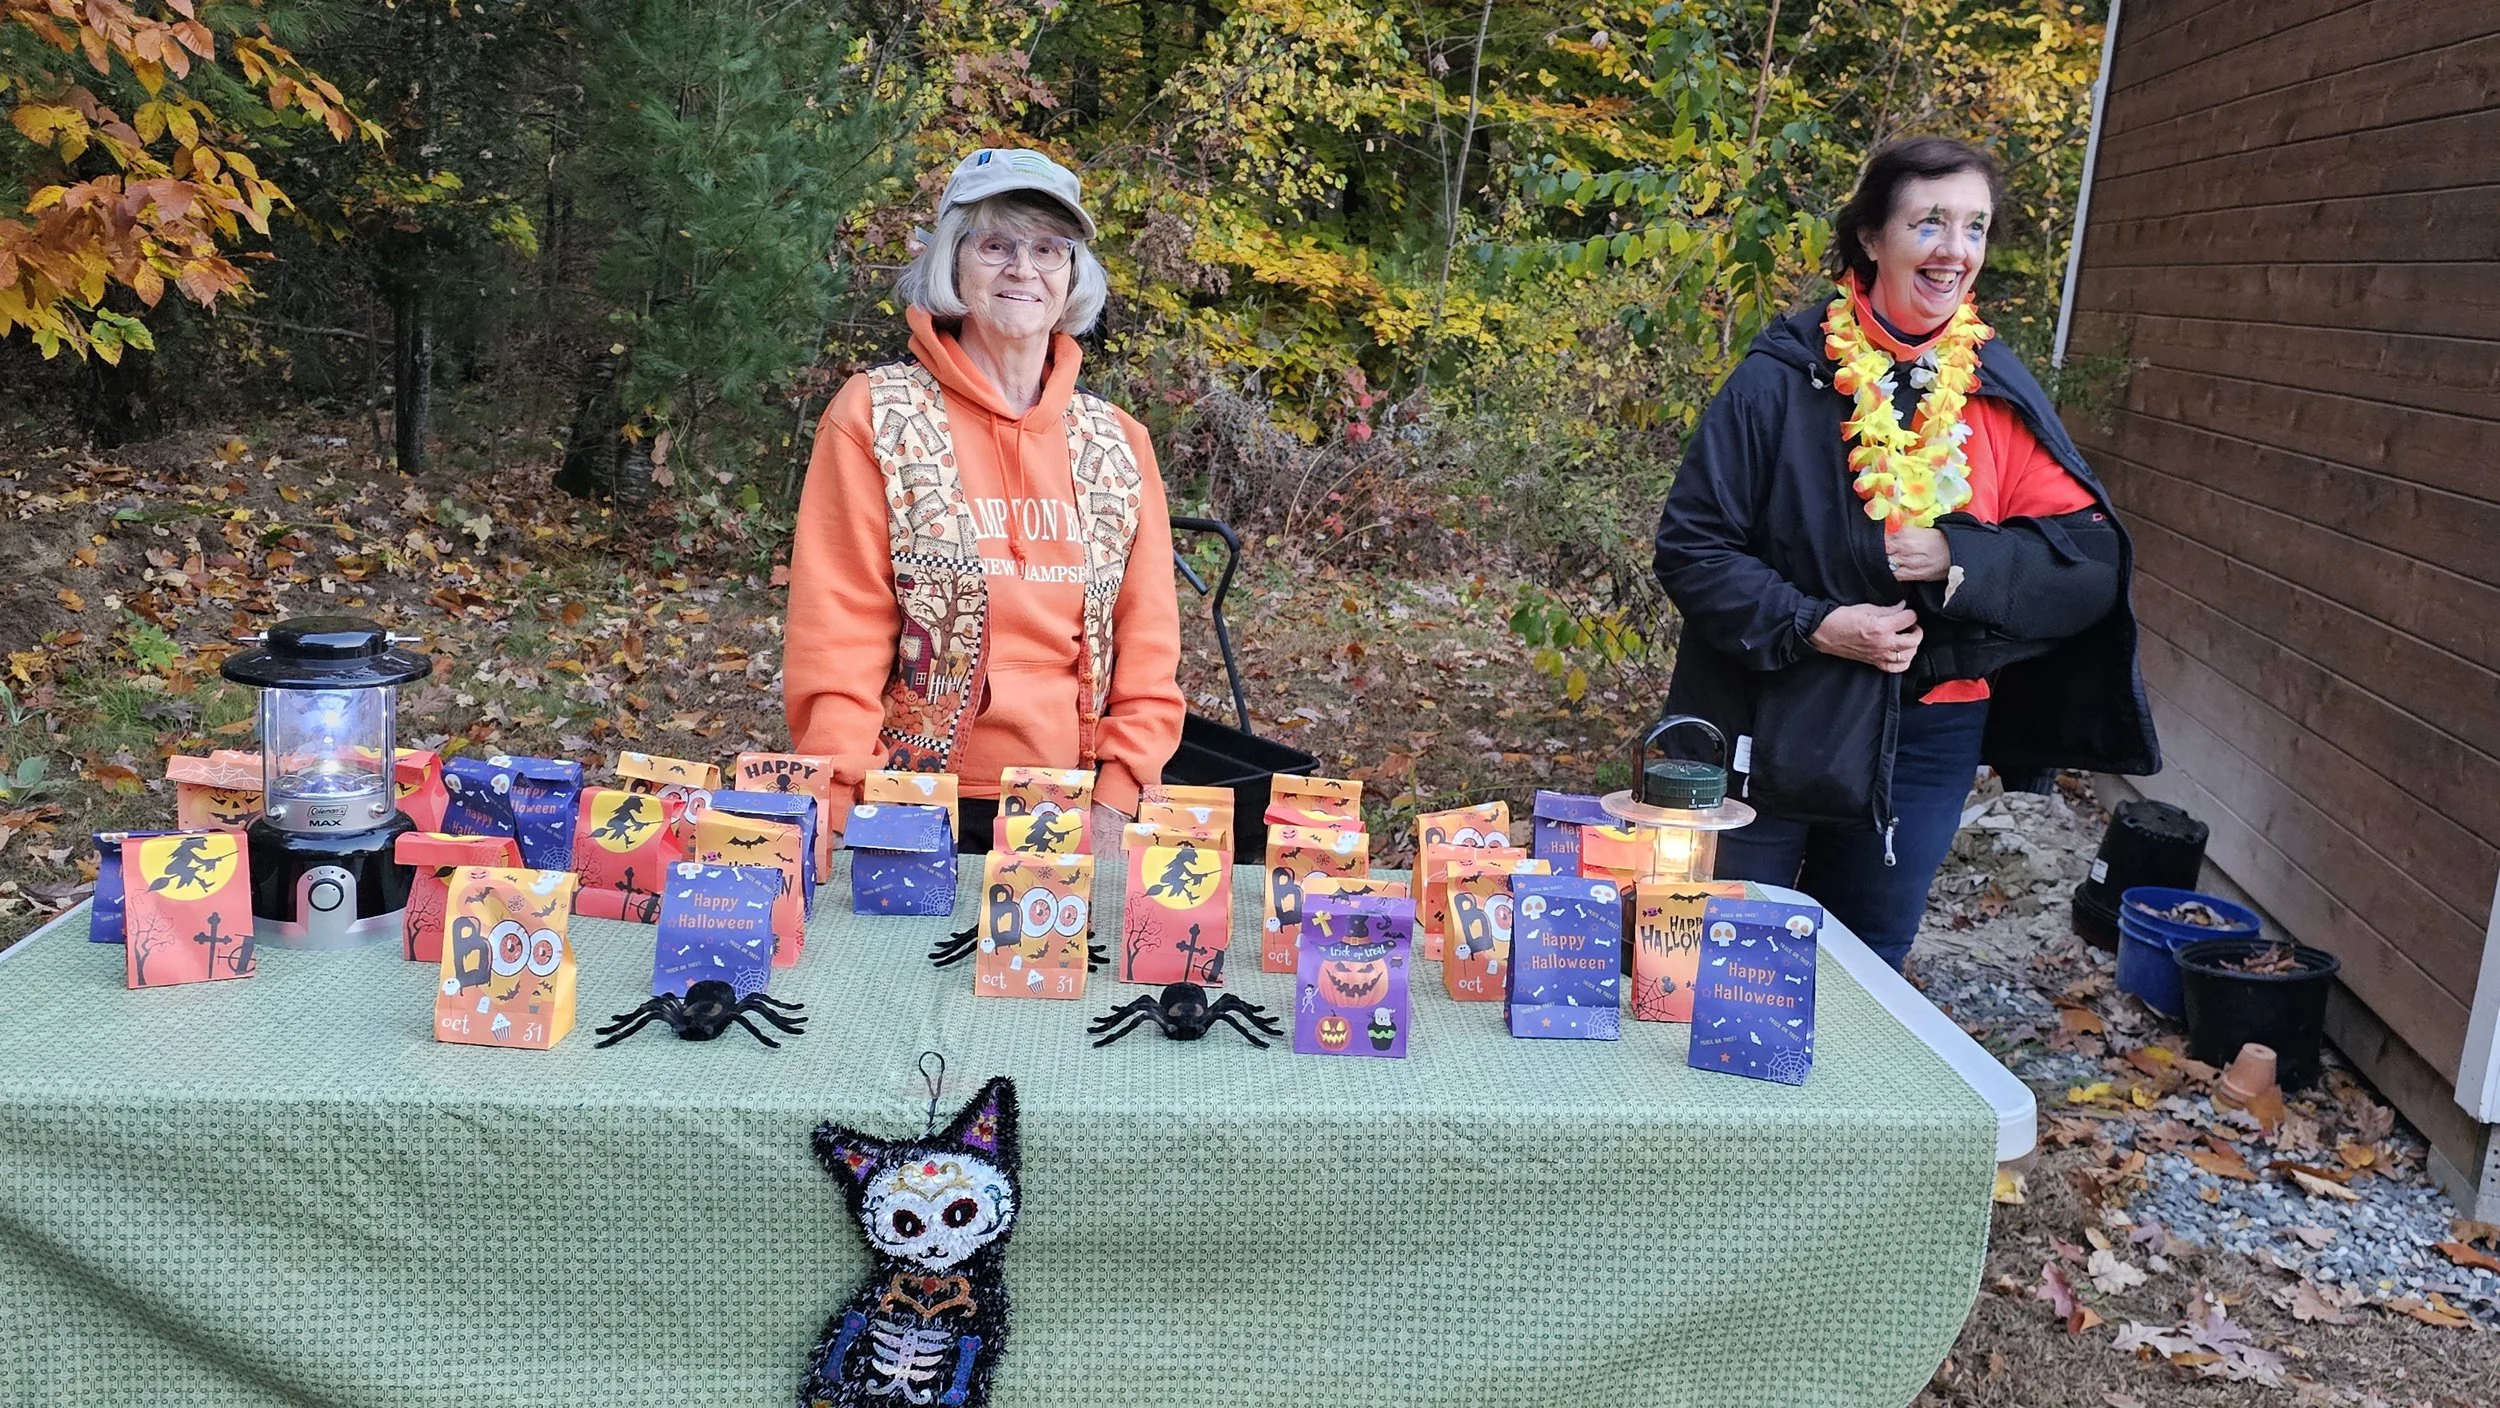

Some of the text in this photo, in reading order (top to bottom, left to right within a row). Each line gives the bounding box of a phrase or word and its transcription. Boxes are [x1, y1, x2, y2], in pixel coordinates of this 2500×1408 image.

[980, 558, 1015, 576] NEW
[744, 760, 818, 780] HAPPY
[310, 806, 340, 816] Coleman
[511, 799, 557, 814] lloween
[309, 819, 342, 827] MAX
[1560, 822, 1582, 839] Hap
[1551, 840, 1581, 854] Hallo
[694, 893, 739, 912] Happy
[678, 913, 754, 930] Halloween
[989, 884, 1087, 955] BOO
[1670, 915, 1703, 934] HAPP
[1542, 932, 1586, 951] Happy
[1640, 924, 1702, 957] HALLOW
[452, 916, 563, 996] BOO
[1268, 949, 1292, 966] oct
[1330, 944, 1386, 960] trick or treat
[1531, 954, 1606, 970] Halloween
[982, 971, 1074, 993] oct 31
[1729, 962, 1776, 986] Happy
[1458, 976, 1484, 993] oct
[1714, 983, 1795, 1009] Halloween
[441, 1014, 543, 1042] oct 31
